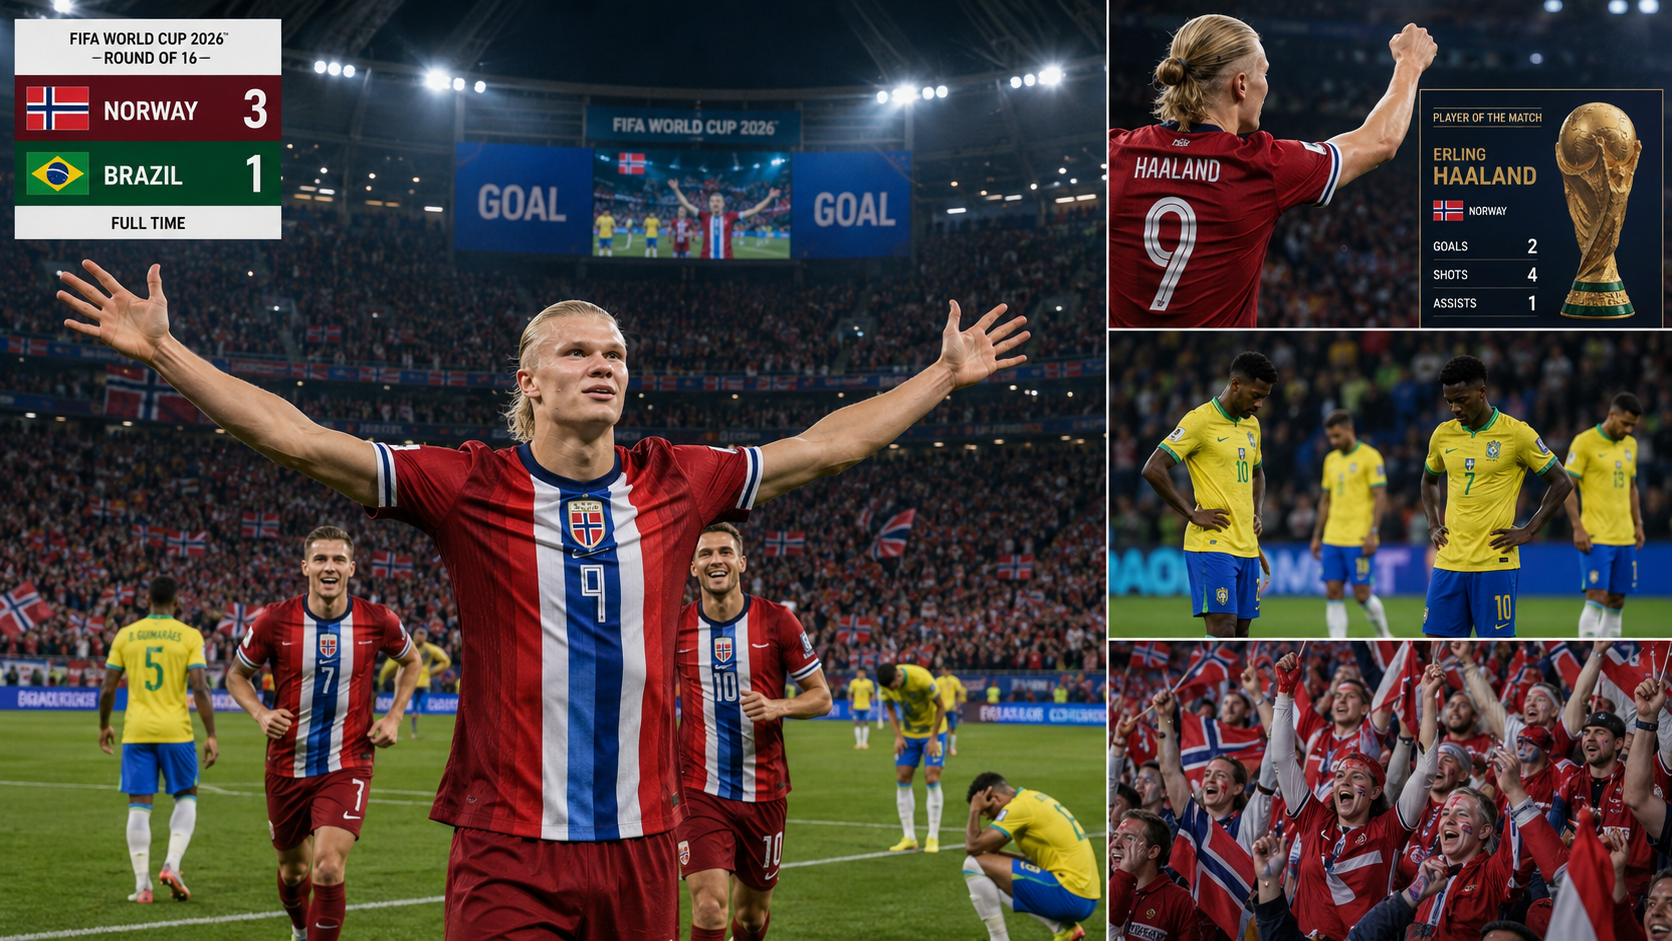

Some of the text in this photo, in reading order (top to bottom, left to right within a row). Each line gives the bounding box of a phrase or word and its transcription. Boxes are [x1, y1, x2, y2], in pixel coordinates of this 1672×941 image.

[613, 117, 646, 133] FIFA
[648, 118, 703, 134] WORLD
[706, 120, 737, 135] CUP
[1134, 156, 1221, 183] HAALAND
[478, 183, 567, 222] GOAL
[814, 191, 896, 227] GOAL
[1144, 196, 1197, 311] 9
[1236, 461, 1249, 483] 10
[1464, 472, 1475, 495] 7
[580, 564, 606, 623] 9
[1494, 594, 1512, 621] 10
[145, 646, 164, 691] 5
[321, 666, 335, 694] 7
[713, 671, 738, 702] 10
[352, 778, 365, 812] 7
[763, 831, 783, 868] 10
